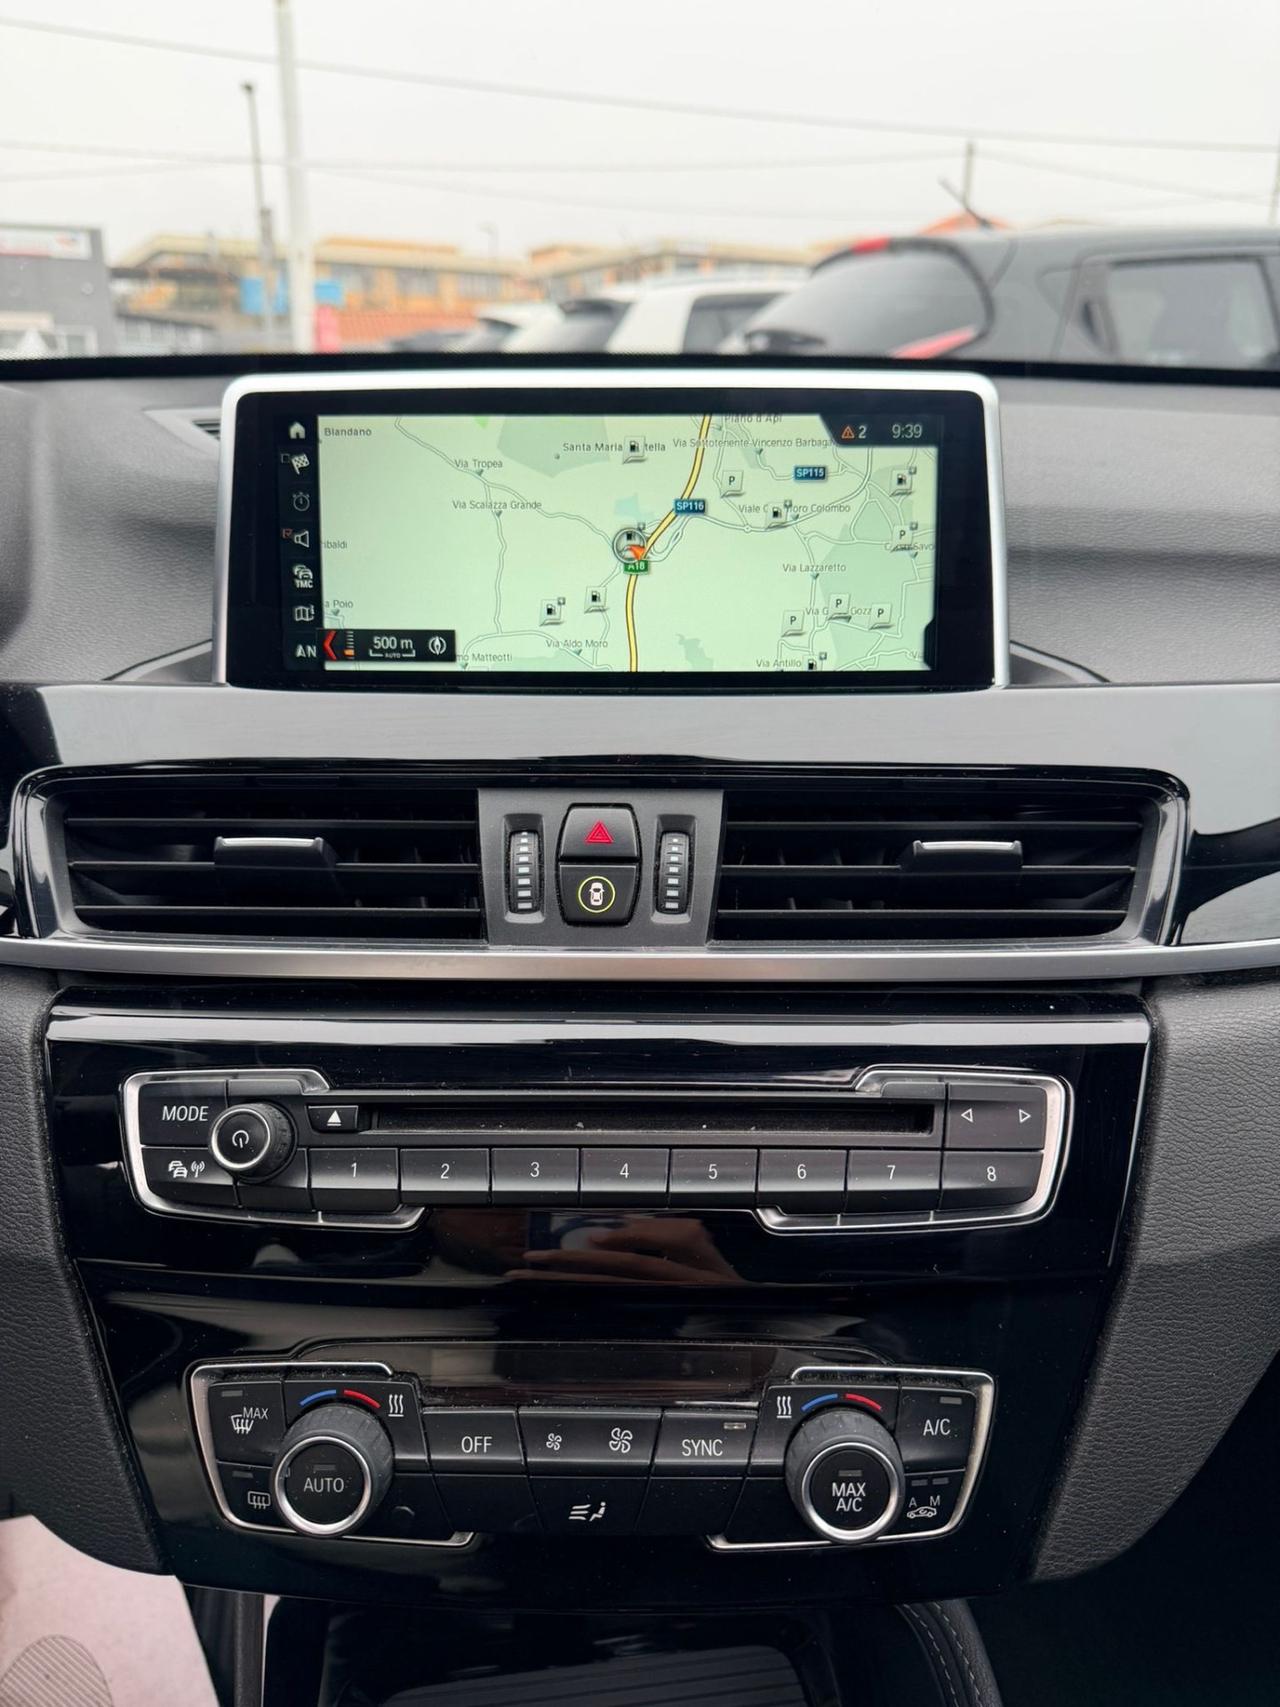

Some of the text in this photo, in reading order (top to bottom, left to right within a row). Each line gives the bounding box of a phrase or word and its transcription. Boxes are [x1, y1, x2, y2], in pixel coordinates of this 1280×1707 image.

[858, 425, 868, 439] 2
[892, 424, 922, 439] 9:39
[563, 442, 666, 452] Santa Maria tella
[672, 438, 687, 448] Via
[751, 438, 793, 448] Vincenzo
[454, 459, 503, 471] Via Tropea
[795, 468, 825, 478] SP115
[728, 475, 736, 486] P
[452, 500, 467, 510] Via
[510, 500, 542, 510] Grande
[676, 501, 705, 511] SP116
[739, 503, 761, 513] Viale
[811, 503, 851, 513] Colombo
[782, 563, 847, 573] Via Lazzaretto
[294, 579, 314, 589] TMC
[835, 598, 843, 609] P
[805, 608, 820, 617] Via
[850, 607, 872, 616] Gozz
[877, 607, 885, 618] P
[789, 615, 797, 625] P
[373, 636, 414, 650] 500 m
[545, 639, 609, 649] Via Aldo Moro
[472, 652, 513, 663] Matteotti
[756, 658, 802, 668] Via Antillo
[162, 1105, 209, 1122] MODE
[351, 1161, 358, 1178] 1
[440, 1163, 450, 1180] 2
[530, 1161, 540, 1178] 3
[619, 1163, 630, 1179] 4
[707, 1163, 718, 1180] 5
[796, 1163, 807, 1180] 6
[887, 1164, 896, 1181] 7
[986, 1165, 997, 1182] 8
[242, 1406, 269, 1421] MAX
[922, 1418, 951, 1437] A/C
[461, 1436, 492, 1454] OFF
[681, 1438, 724, 1458] SYNC
[303, 1477, 345, 1493] AUTO
[831, 1482, 866, 1497] MAX
[835, 1498, 863, 1512] A/C
[908, 1495, 941, 1508] A M
